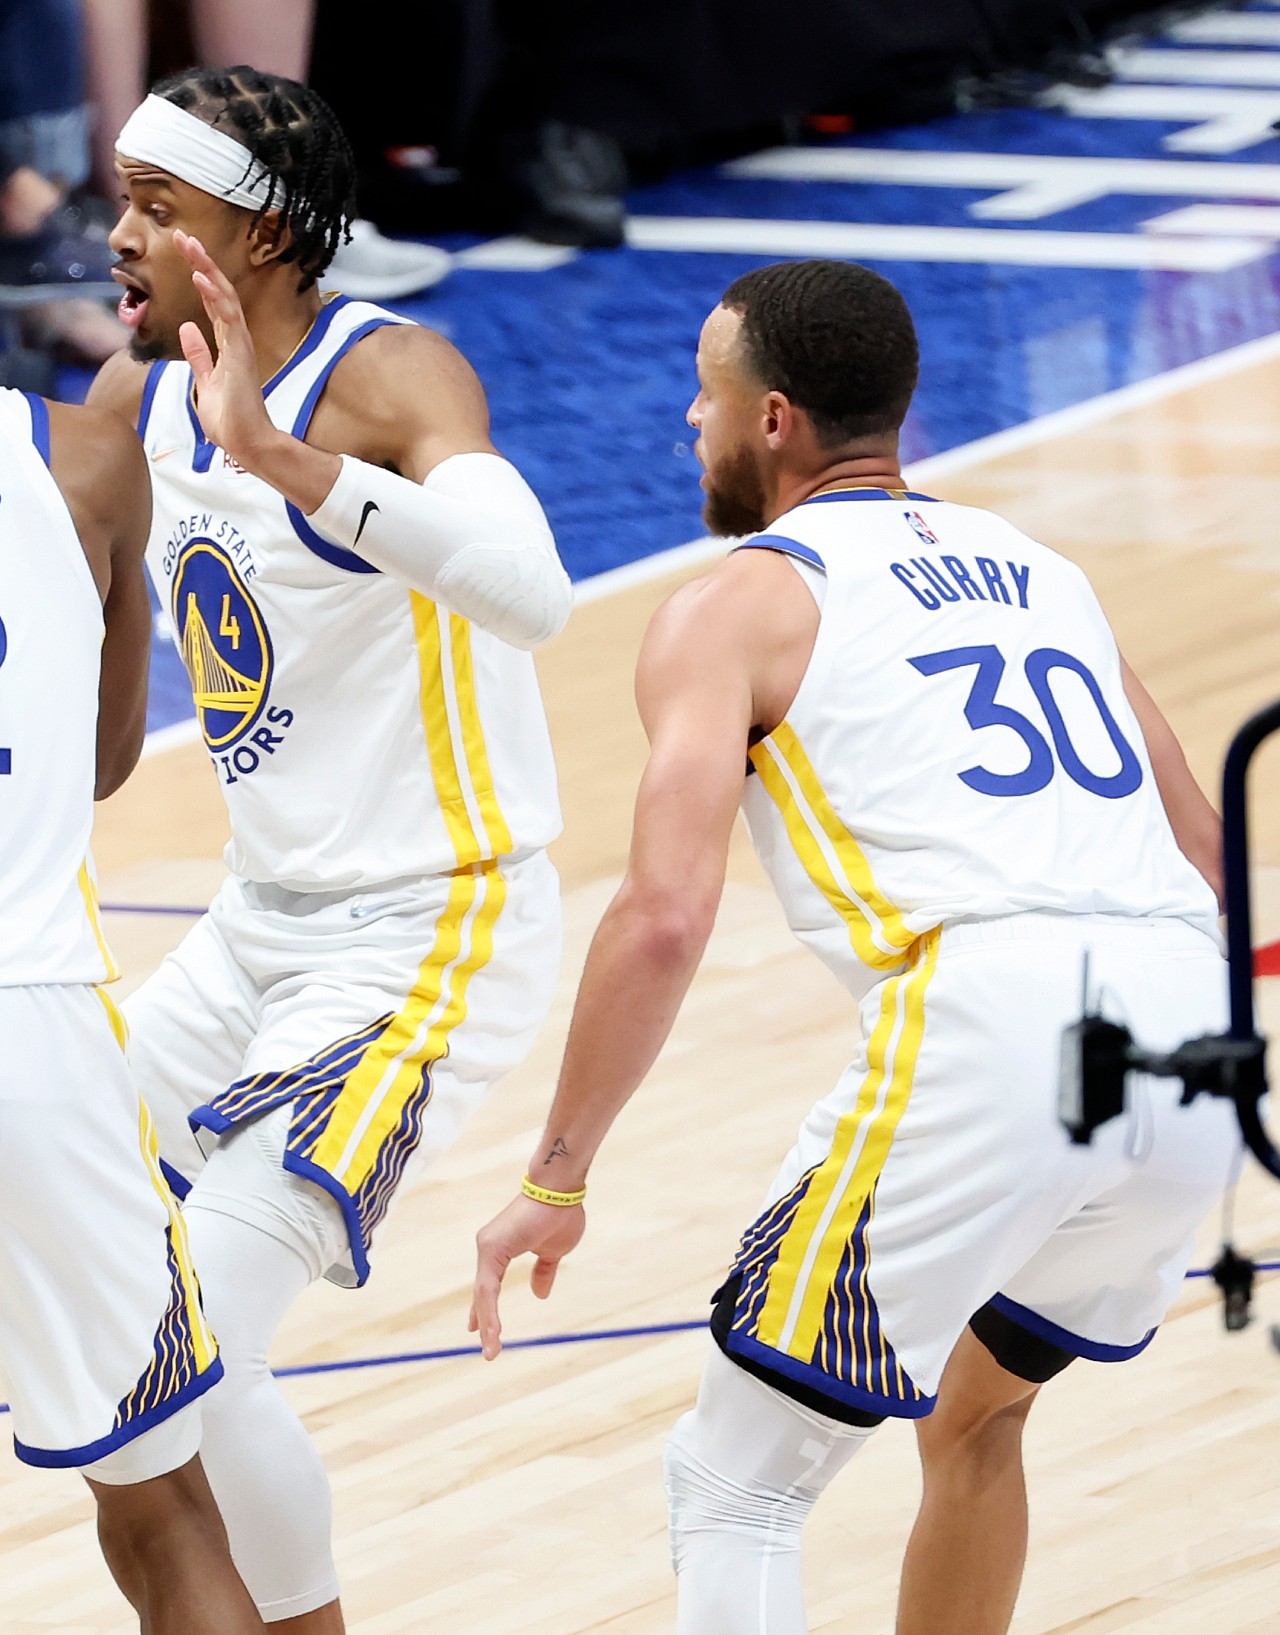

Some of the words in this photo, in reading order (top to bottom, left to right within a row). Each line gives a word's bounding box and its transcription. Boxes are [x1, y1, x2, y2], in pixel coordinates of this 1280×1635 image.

[163, 513, 213, 576] GOLDEN
[216, 520, 257, 584] STATE
[889, 555, 1030, 610] CURRY
[219, 593, 241, 650] 4
[209, 705, 294, 785] IORS
[905, 643, 1143, 799] 30
